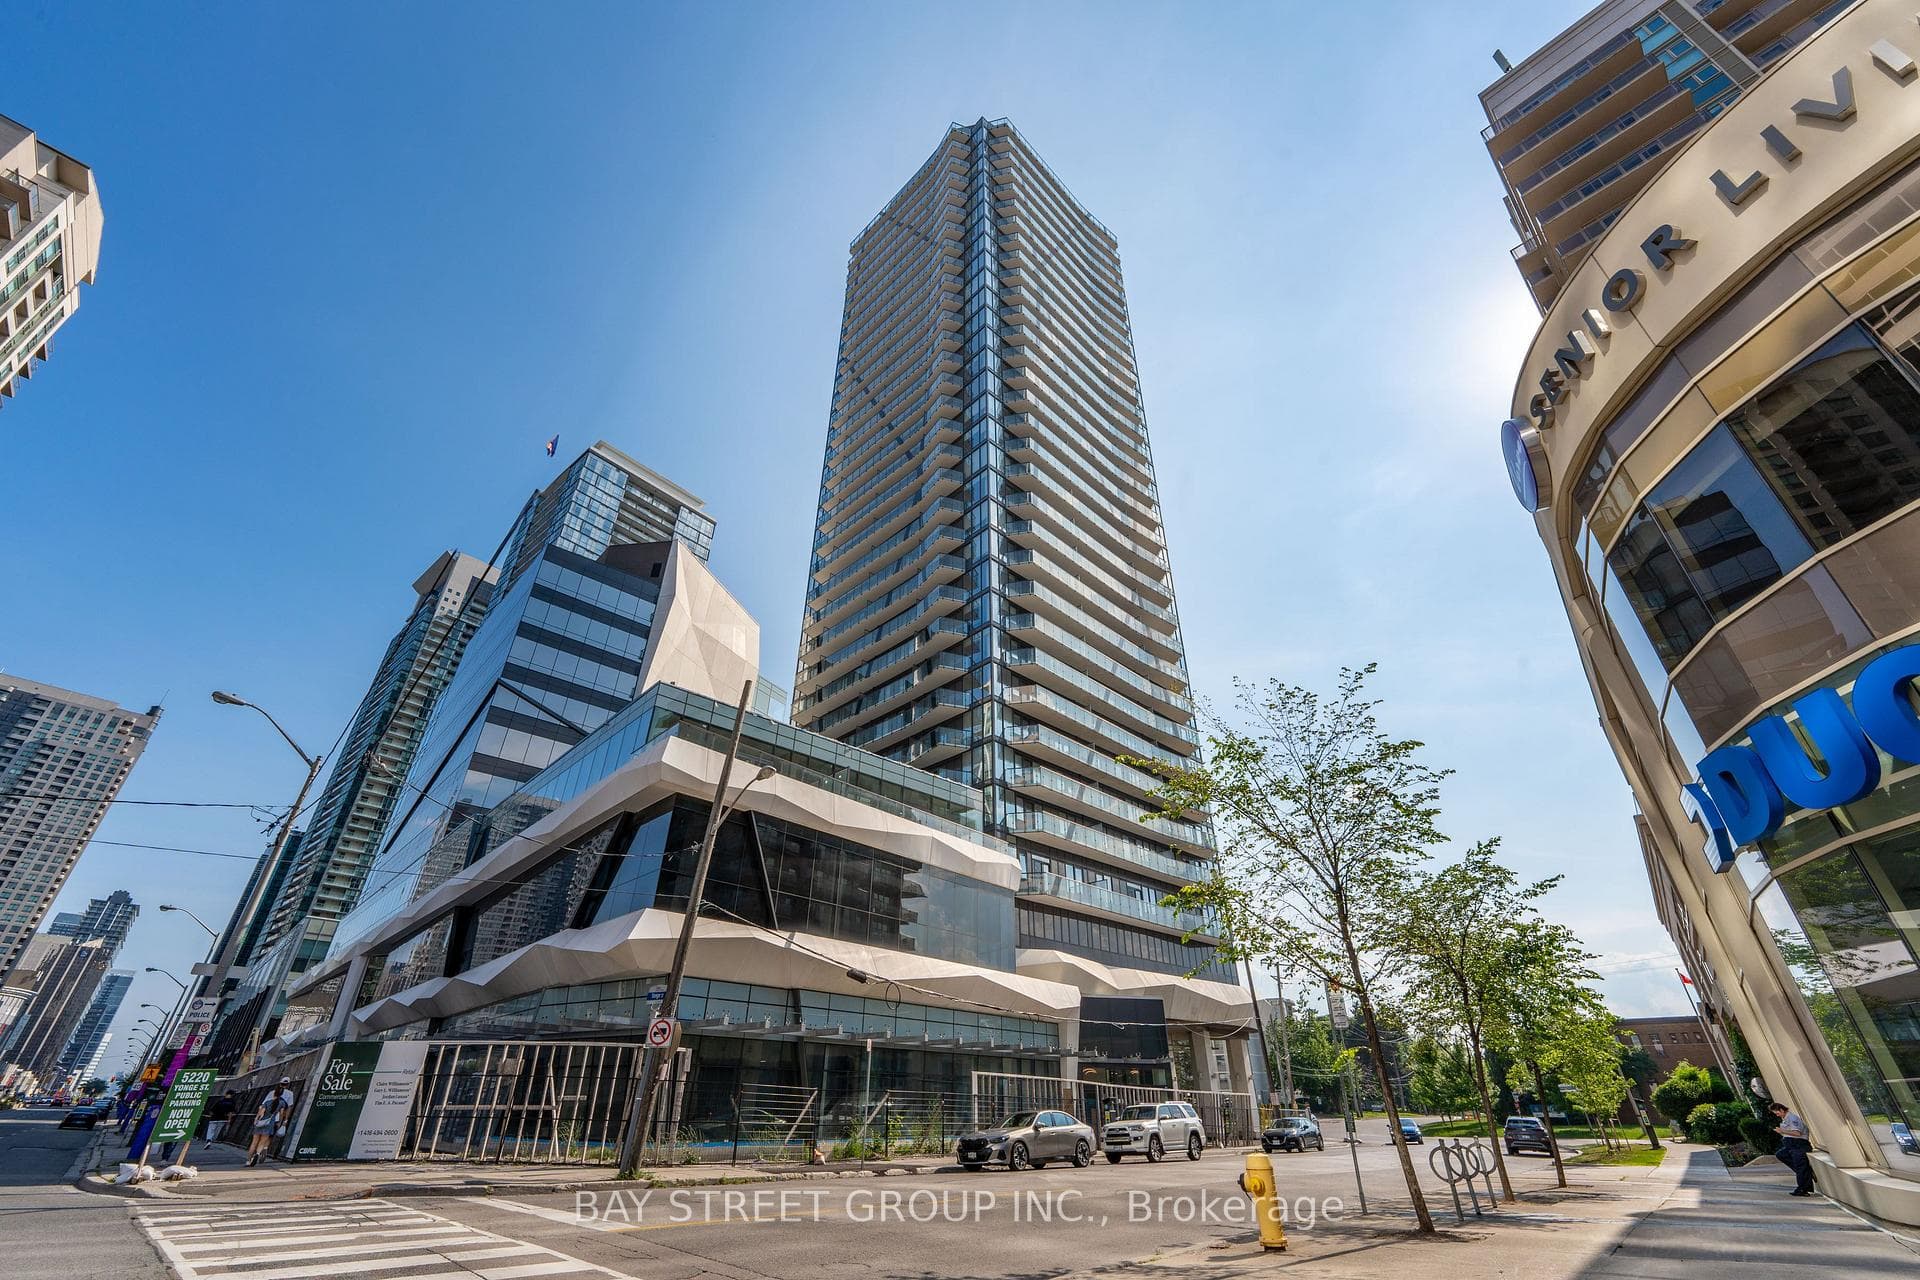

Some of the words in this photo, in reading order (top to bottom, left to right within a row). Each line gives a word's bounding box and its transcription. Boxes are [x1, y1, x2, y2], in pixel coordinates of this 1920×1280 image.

[1530, 223, 1698, 431] SENIOR
[1708, 10, 1920, 207] LIVI
[327, 1059, 354, 1075] For
[181, 1072, 211, 1083] 5220
[322, 1074, 353, 1091] Sale
[174, 1084, 199, 1092] YONGE
[169, 1099, 202, 1107] PARKING
[168, 1109, 194, 1119] NOW
[163, 1119, 191, 1130] OPEN
